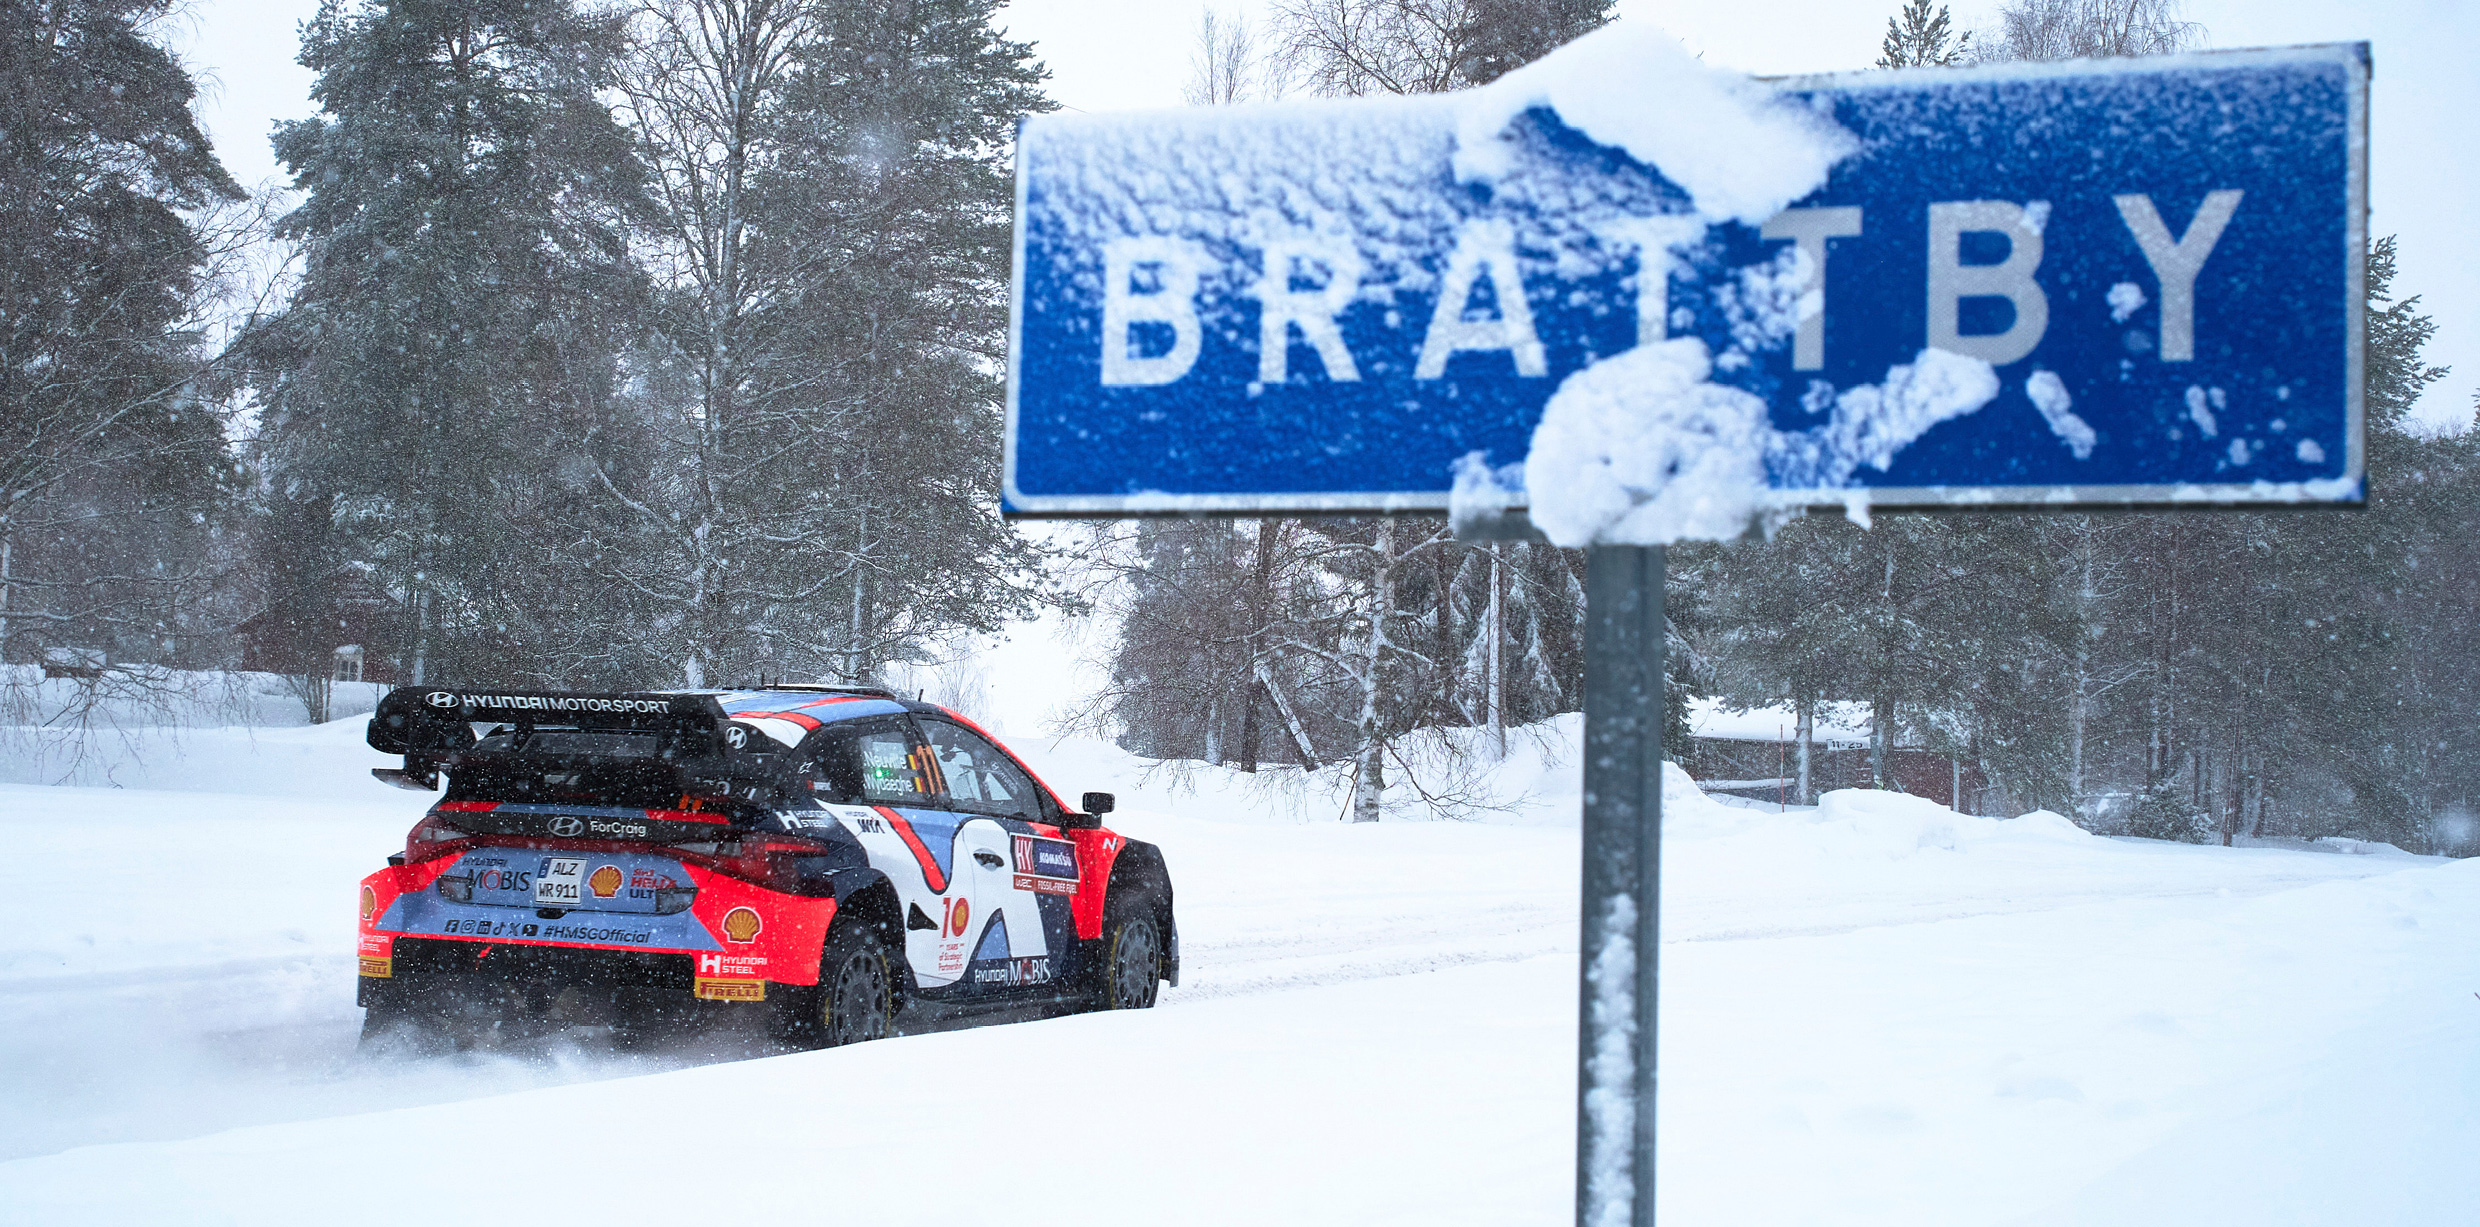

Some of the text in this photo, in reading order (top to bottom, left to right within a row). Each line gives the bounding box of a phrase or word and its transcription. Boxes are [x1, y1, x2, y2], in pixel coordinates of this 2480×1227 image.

[1098, 188, 2246, 388] BRATTBY
[461, 694, 669, 714] HYUNDAI MOTORSPORT
[916, 745, 944, 795] 11
[590, 820, 647, 838] ForCraig
[552, 862, 579, 876] ALZ
[467, 868, 532, 892] MOBIS
[538, 882, 579, 899] WR 911
[544, 925, 651, 944] #HMSGOfficial
[721, 965, 755, 975] STEEL
[722, 956, 768, 966] HYUNDAI
[974, 958, 1051, 987] HYUNDAI MOBIS
[700, 982, 760, 997] PIRELLI
